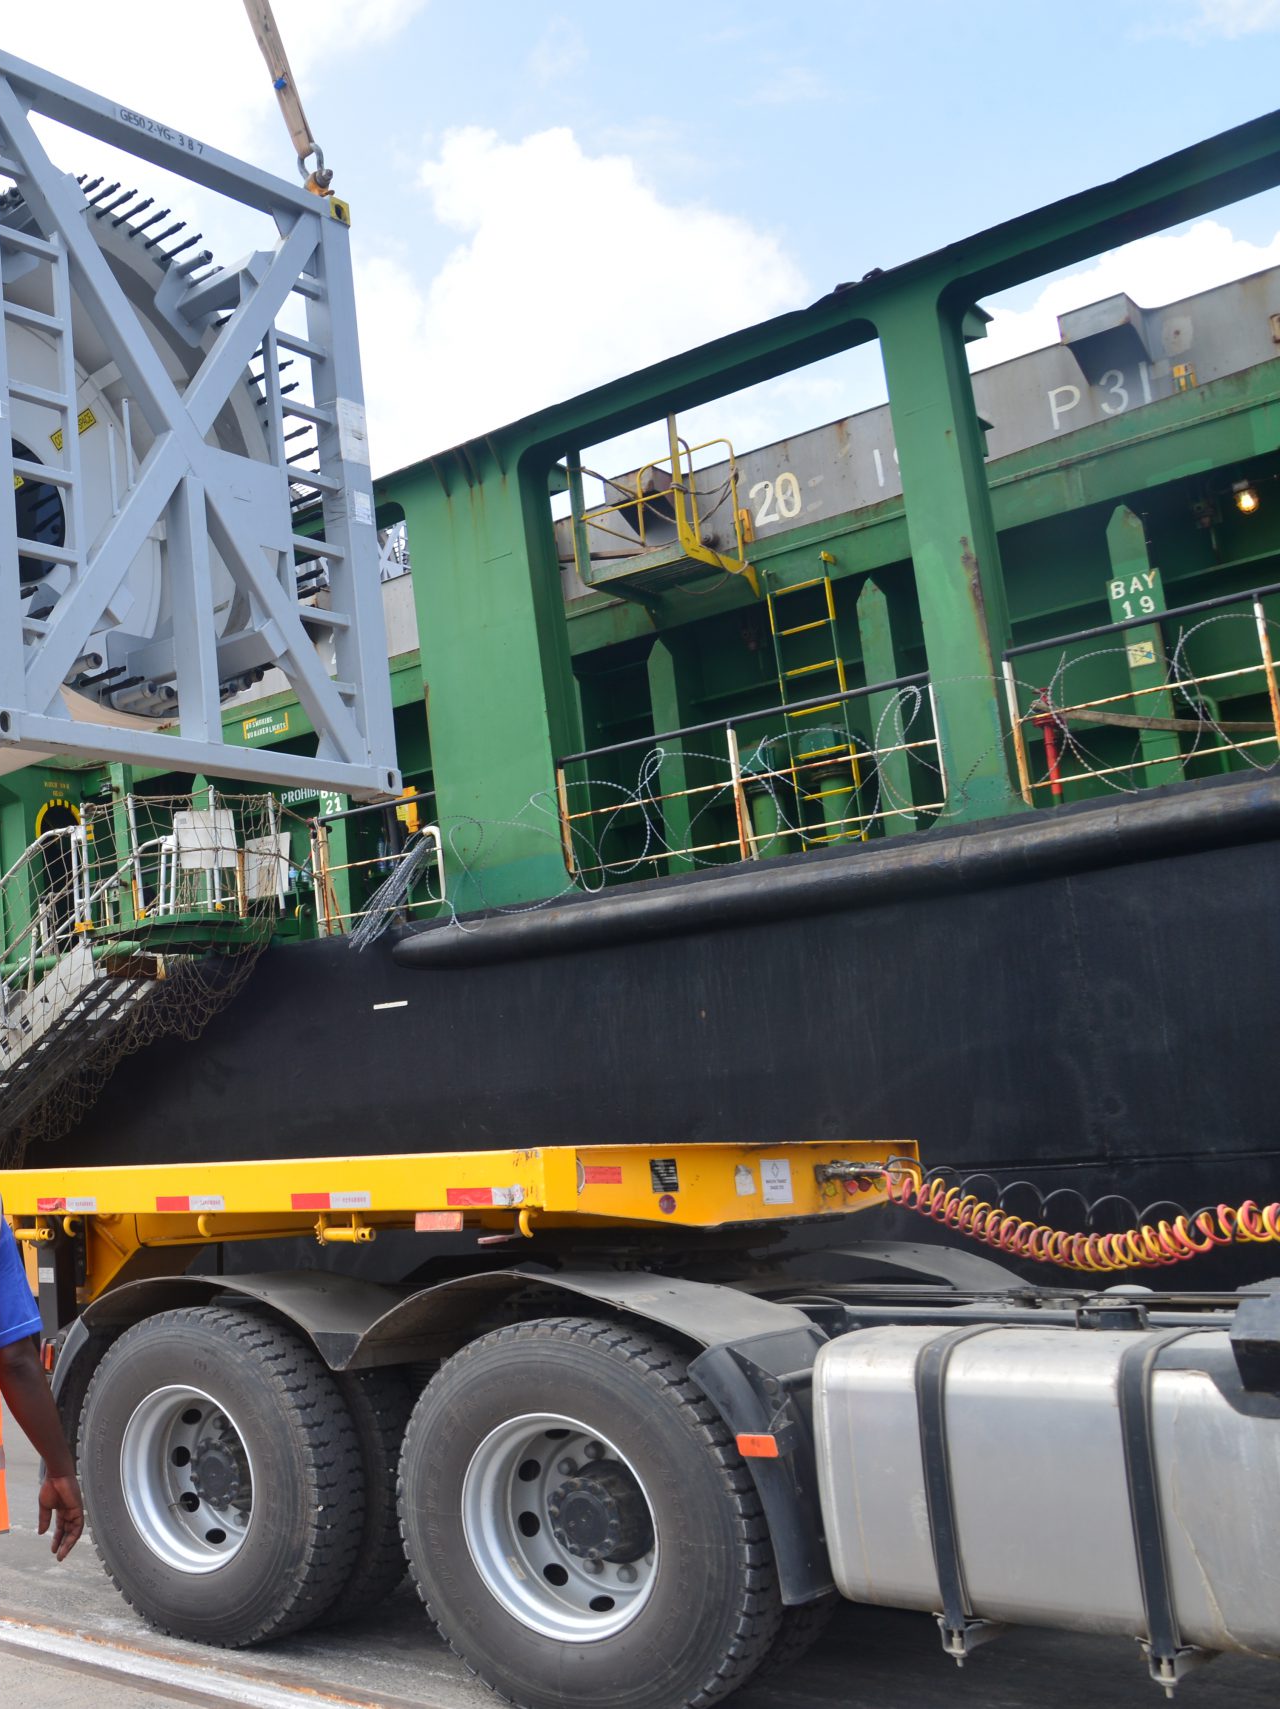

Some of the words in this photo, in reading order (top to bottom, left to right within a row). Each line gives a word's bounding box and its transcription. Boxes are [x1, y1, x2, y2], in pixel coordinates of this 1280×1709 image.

[1110, 570, 1156, 600] BAY
[1122, 595, 1155, 620] 19
[326, 797, 342, 815] 21
